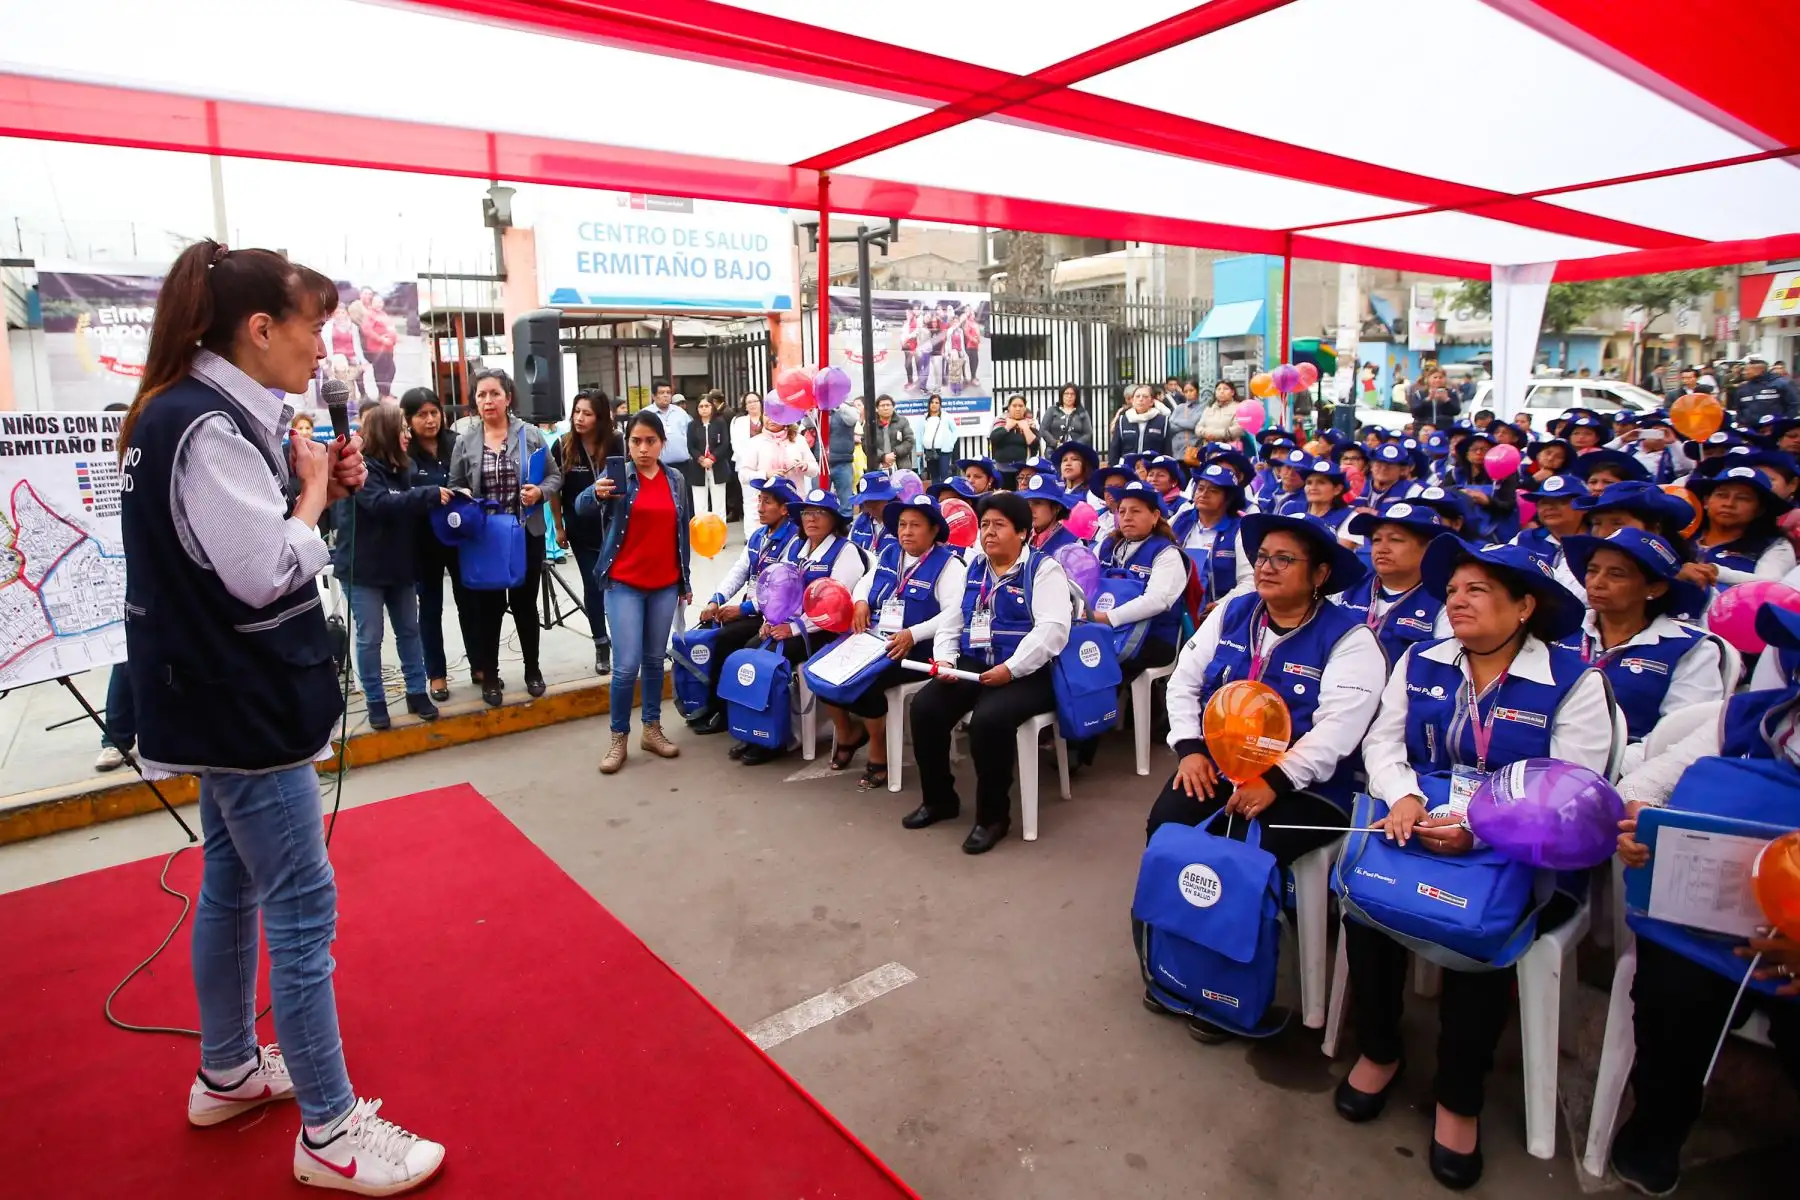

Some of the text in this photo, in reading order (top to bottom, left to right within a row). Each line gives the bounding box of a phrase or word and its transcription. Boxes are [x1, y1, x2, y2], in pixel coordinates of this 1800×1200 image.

[578, 221, 768, 252] CENTRO DE SALUD
[577, 250, 771, 281] ERMITAÑO BAJO
[3, 413, 121, 435] NIÑOS CON AN
[0, 436, 96, 456] RMITAÑO
[1182, 880, 1216, 897] COMUNITARIO
[1184, 871, 1218, 891] AGENTE
[1185, 887, 1211, 901] EN SALUD
